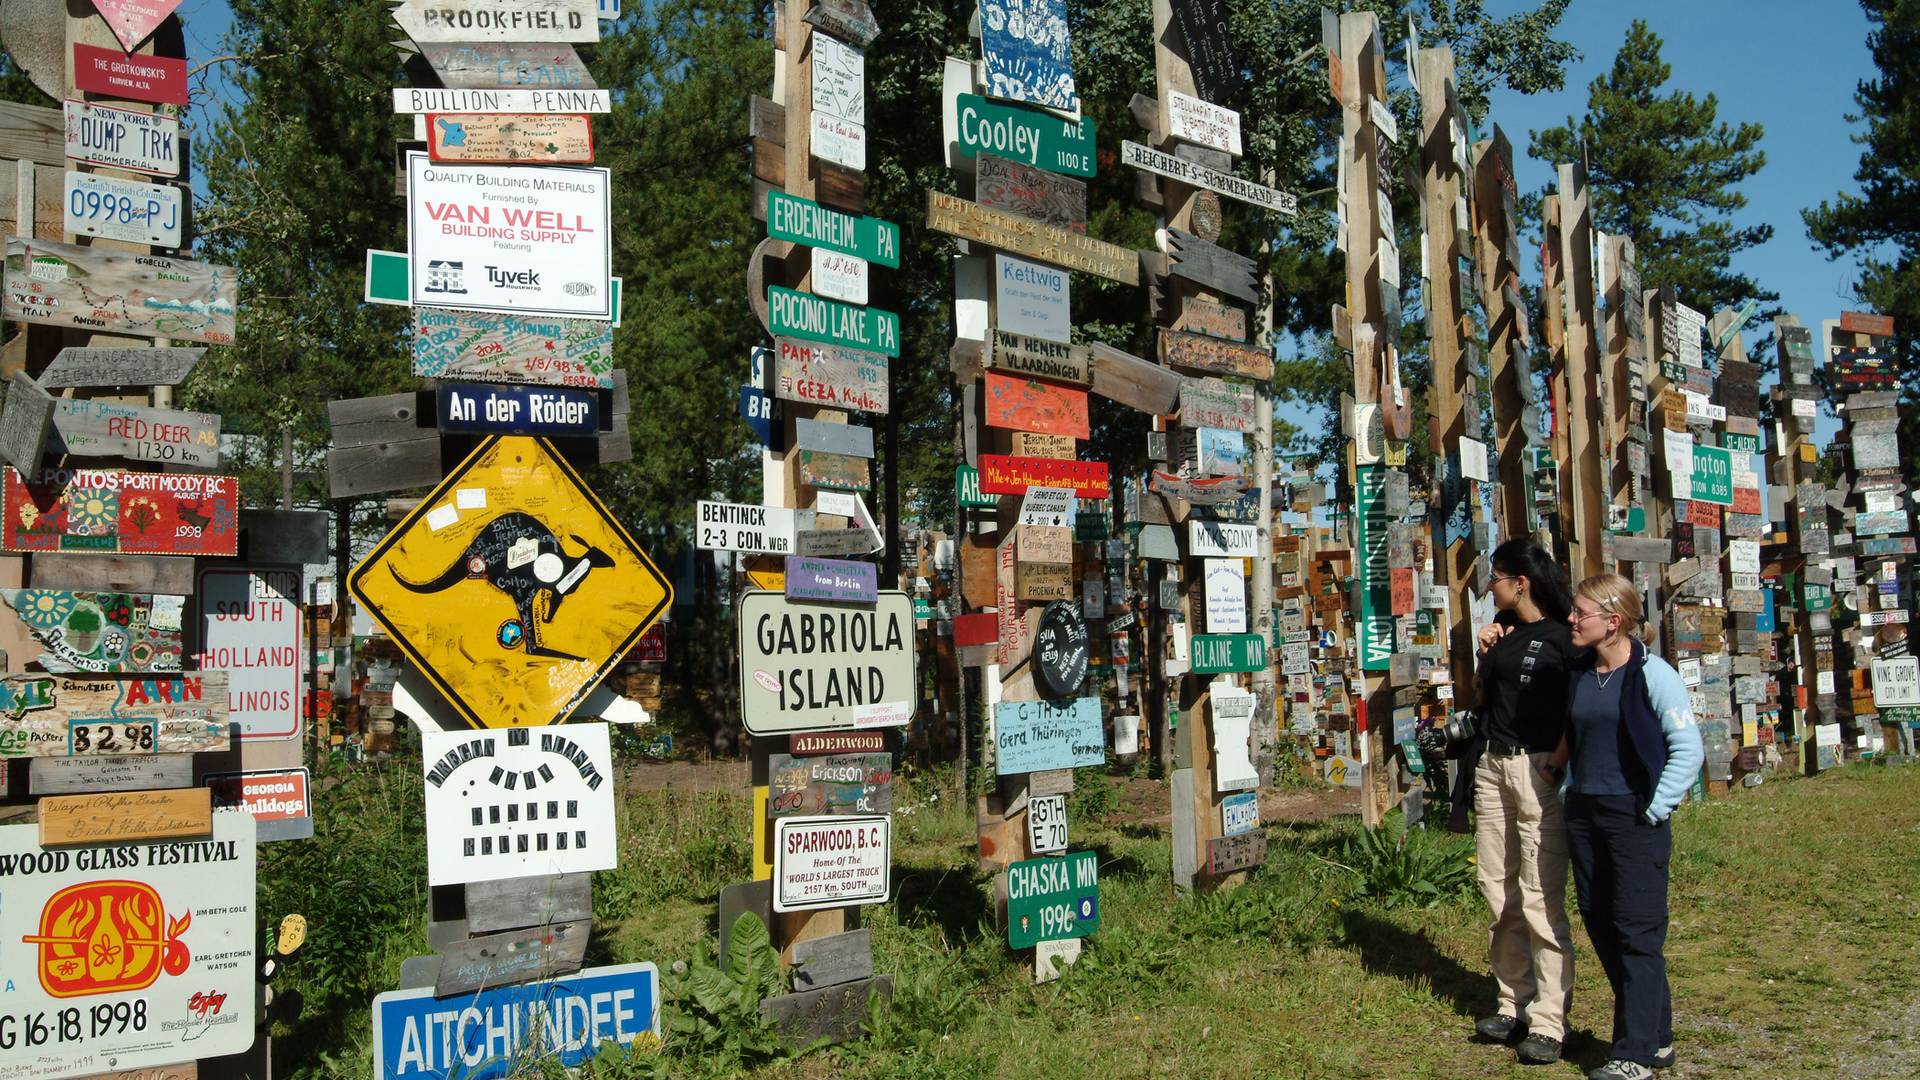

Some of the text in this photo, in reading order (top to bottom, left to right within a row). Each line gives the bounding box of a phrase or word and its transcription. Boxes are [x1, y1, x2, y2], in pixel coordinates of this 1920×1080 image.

[424, 10, 582, 30] BROOKFIELD
[94, 58, 166, 80] THE GROTKOWSKI'S
[109, 76, 134, 88] FAIRVIEW,
[532, 92, 603, 112] PENNA
[94, 108, 149, 125] NEW YORK
[81, 117, 173, 162] DUMP TRK
[962, 107, 1085, 164] Cooley AVE
[91, 153, 152, 170] COMMERCIAL
[1058, 150, 1088, 172] 1100 E
[424, 170, 595, 194] QUALITY BUILDING MATERIALS
[1135, 147, 1272, 205] REICHERT'S SUMMERLAND
[112, 184, 136, 198] British
[482, 192, 538, 206] Furnished By
[71, 189, 132, 225] 0998
[424, 202, 594, 233] VAN WELL
[442, 222, 576, 244] BUILDING SUPPLY
[774, 197, 894, 260] ERDENHEIM, PA
[494, 240, 532, 252] Featuring
[136, 257, 171, 268] ISABELLA
[485, 266, 541, 288] Tyvek
[1004, 262, 1061, 292] Kettwig
[506, 284, 542, 292] Housewrap
[22, 308, 52, 319] ITALY
[73, 315, 106, 328] ANDREA
[772, 291, 895, 350] POCONO LAKE, PA
[503, 316, 561, 341] SKINNER
[782, 342, 811, 364] PAM
[1000, 332, 1070, 360] VAN HEMERT
[526, 356, 570, 374] 1/8/98
[1006, 352, 1080, 380] VLAARDINGEN
[563, 376, 596, 388] PERTH
[68, 400, 138, 418] Jeff Johnstone
[450, 392, 588, 425] An der Röder
[1706, 406, 1722, 420] MICH
[108, 418, 191, 444] RED DEER
[137, 442, 200, 462] 1730 km
[1726, 436, 1757, 454] ST-ALEXIS
[1693, 454, 1726, 476] ngton
[162, 477, 226, 495] MOODY B.C.
[988, 468, 1004, 484] Mike
[174, 490, 200, 500] AUGUST
[1034, 490, 1048, 500] GENO
[1692, 482, 1728, 497] TION 8385
[703, 504, 766, 527] BENTINCK
[1026, 504, 1066, 513] QUEBEC CANADA
[174, 526, 202, 539] 1998
[704, 528, 728, 548] 2-3
[737, 530, 766, 552] CON.
[769, 536, 788, 552] WGR
[1026, 526, 1040, 538] The
[1002, 543, 1013, 569] 1996
[815, 574, 860, 589] from Berlin
[1056, 586, 1065, 596] AZ
[216, 600, 282, 622] SOUTH
[757, 612, 904, 656] GABRIOLA
[1367, 614, 1393, 663] IOWA
[203, 646, 294, 670] HOLLAND
[1000, 644, 1008, 664] DAN
[1042, 650, 1058, 665] KELLY
[1194, 640, 1262, 668] BLAINE MN
[1876, 664, 1916, 682] VINE GROVE
[126, 676, 202, 706] AARON
[778, 665, 885, 712] ISLAND
[1886, 686, 1910, 698] CITY LIMIT
[228, 690, 289, 712] LINOIS
[796, 734, 884, 753] ALDERWOOD
[1032, 724, 1082, 744] Thüringen
[1072, 740, 1104, 758] Germany
[426, 728, 604, 792] OREGON TO ALASKA
[812, 763, 862, 782] Erickson
[243, 783, 294, 796] GEORGIA
[239, 797, 304, 815] Bulldogs
[472, 800, 578, 826] BENDER
[856, 796, 875, 813] B.C.
[1038, 798, 1064, 822] GTH
[464, 831, 586, 857] REUNION
[788, 828, 856, 855] SPARWOOD,
[1034, 822, 1066, 850] E 70
[0, 841, 239, 876] WOOD GLASS FESTIVAL
[848, 856, 861, 865] The
[822, 869, 854, 880] LARGEST
[1009, 856, 1098, 901] CHASKA MN
[804, 880, 867, 895] 2157 Km. SOUTH
[1040, 903, 1072, 938] 1996
[207, 962, 238, 970] WATSON
[188, 990, 227, 1013] Enjoy
[91, 998, 148, 1040] 1998
[162, 1022, 179, 1032] The
[180, 1018, 204, 1030] Hoosier
[73, 1056, 94, 1069] 1999
